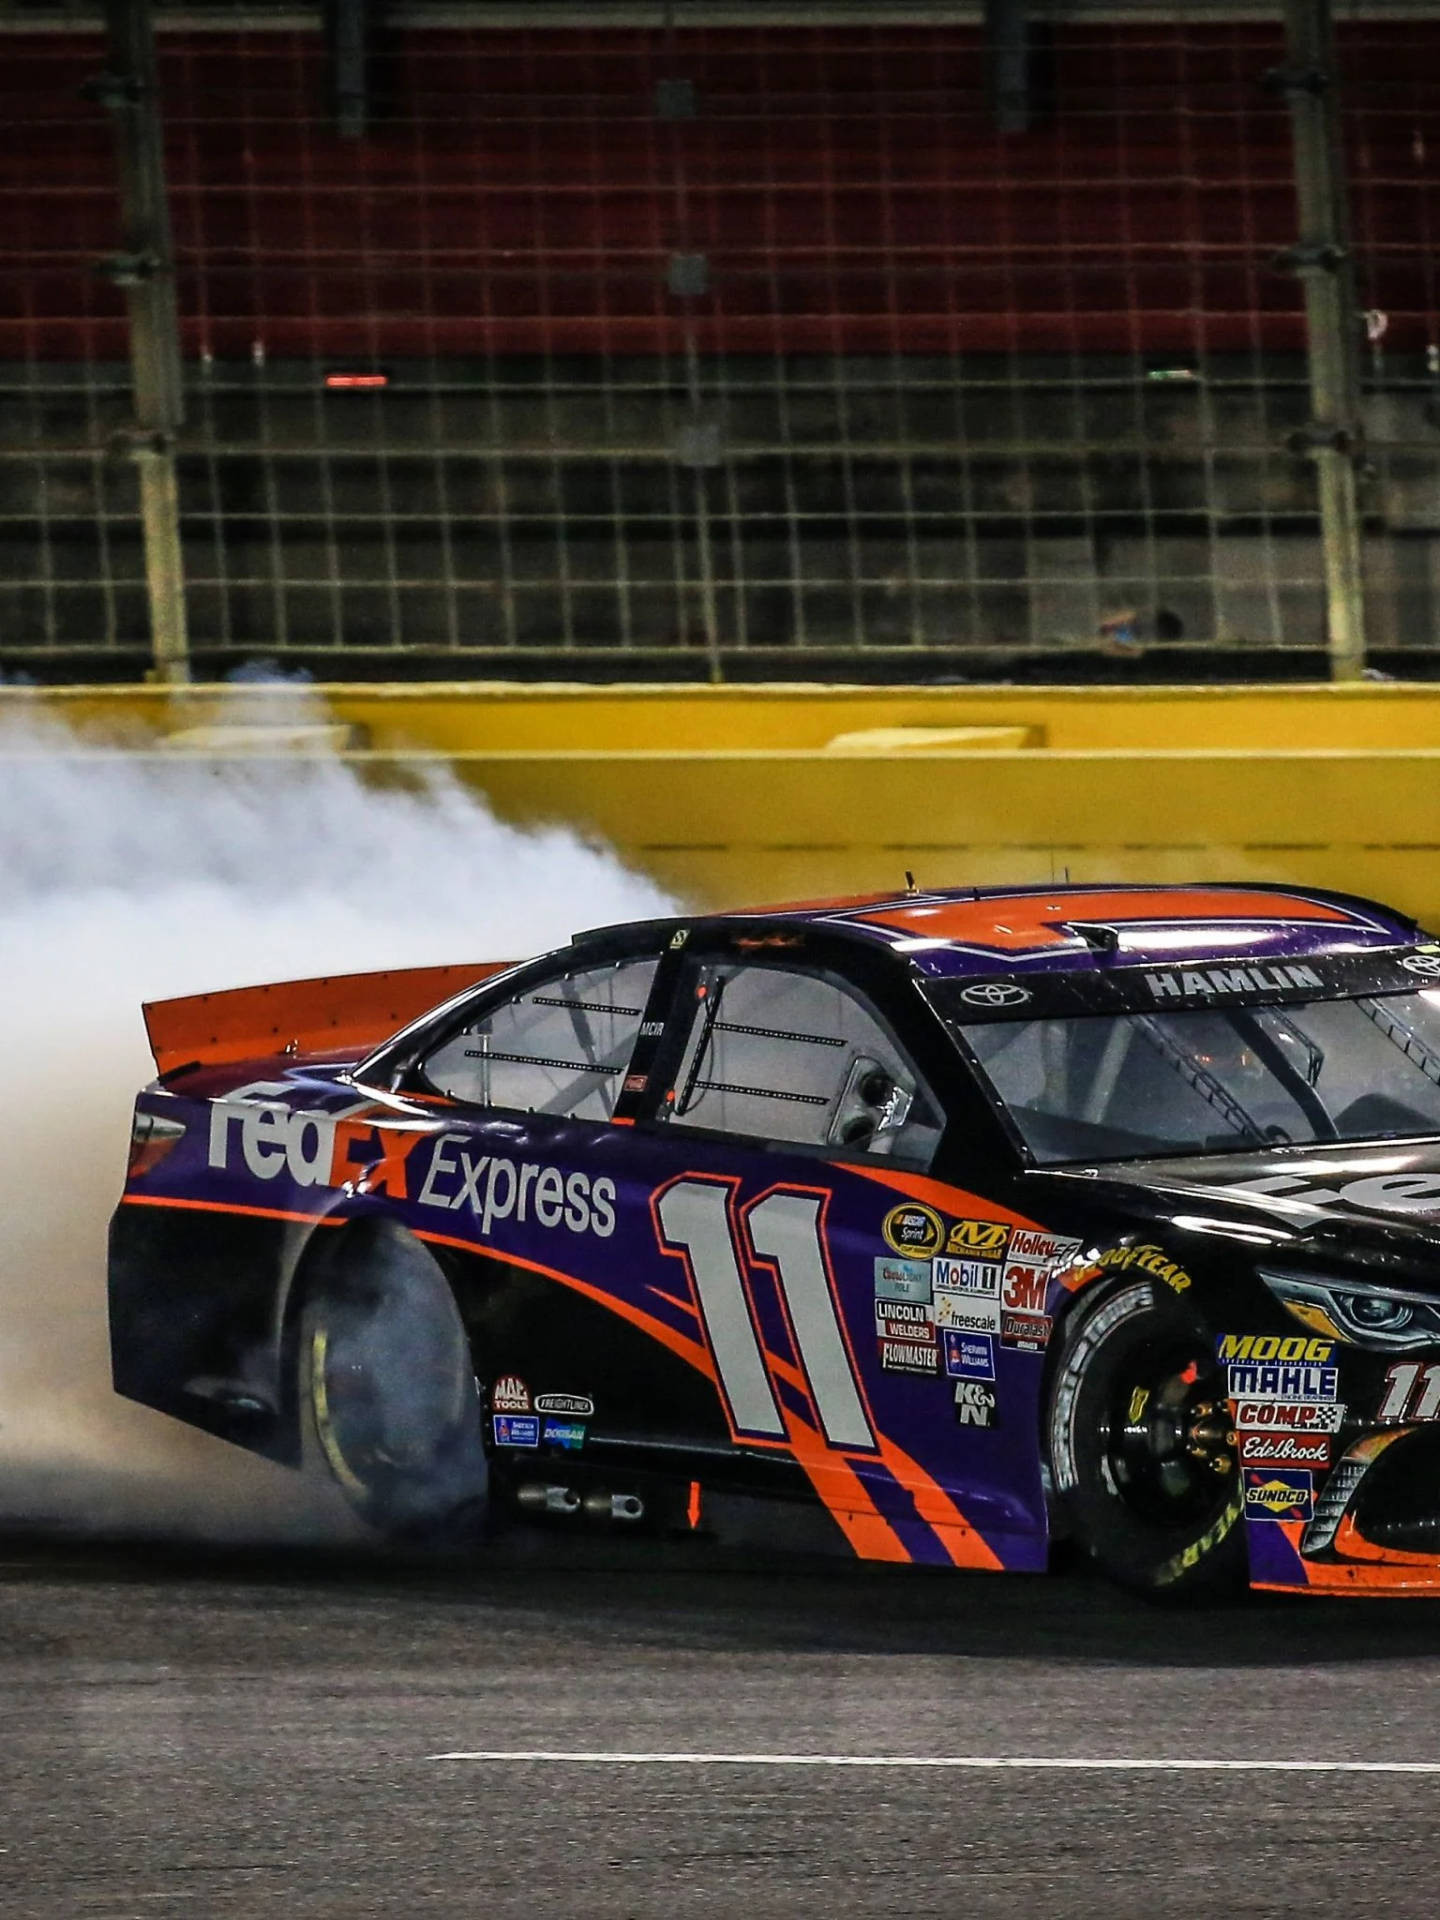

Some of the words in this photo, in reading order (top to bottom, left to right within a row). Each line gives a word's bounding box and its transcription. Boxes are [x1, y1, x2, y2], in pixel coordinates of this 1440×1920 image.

[1144, 965, 1325, 997] HAMLIN
[207, 1081, 424, 1199] FedEx
[418, 1134, 617, 1238] Express
[901, 1226, 924, 1241] Sprint
[1011, 1231, 1056, 1258] Holley
[936, 1261, 979, 1288] Mobil
[984, 1266, 996, 1290] 1
[1003, 1265, 1049, 1311] 3M
[652, 1173, 881, 1455] 11
[878, 1303, 925, 1323] LINCOLN
[951, 1311, 996, 1331] freescale
[889, 1322, 930, 1340] WELDERS
[882, 1342, 937, 1368] FLOWMASTER
[1219, 1334, 1335, 1363] MOOG
[1229, 1366, 1336, 1396] MAHLE
[1378, 1361, 1440, 1421] 11
[494, 1400, 529, 1410] TOOLS
[1239, 1403, 1317, 1428] COMP
[1242, 1436, 1330, 1462] Edelbrock
[1246, 1487, 1309, 1505] SUNOCO
